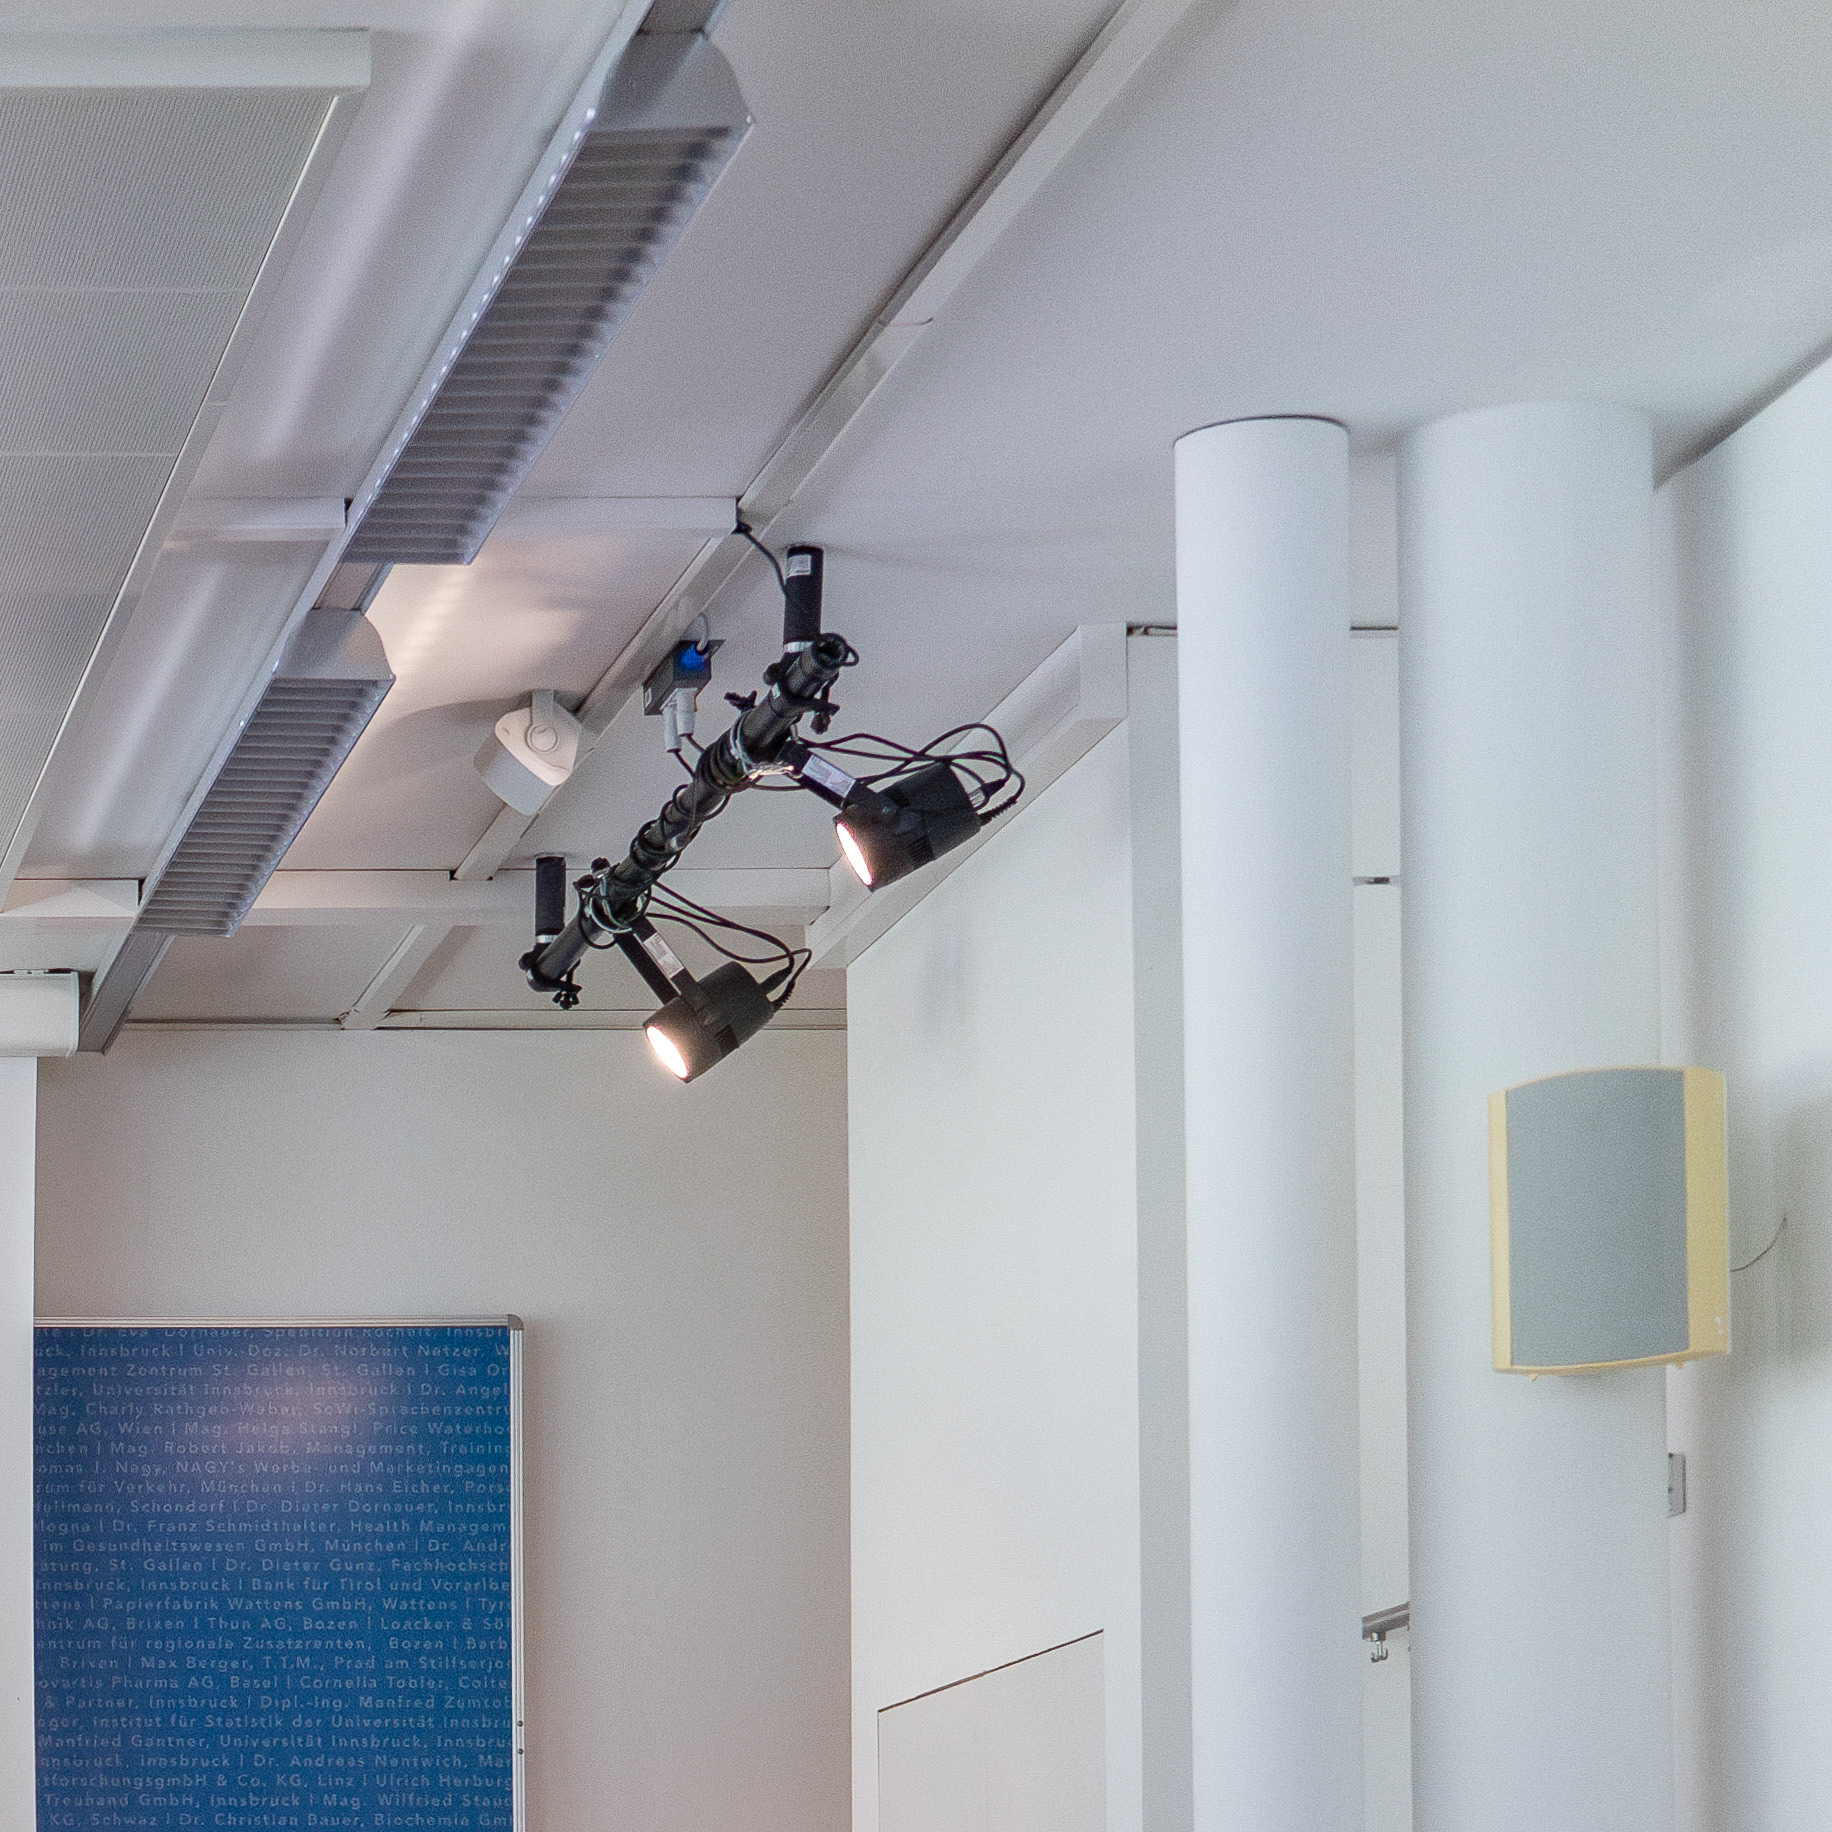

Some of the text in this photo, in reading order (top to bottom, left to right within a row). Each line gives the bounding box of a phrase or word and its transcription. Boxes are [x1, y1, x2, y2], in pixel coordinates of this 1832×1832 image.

[164, 1442, 227, 1454] Robert
[328, 1461, 361, 1474] und
[200, 1480, 283, 1493] München
[339, 1480, 383, 1493] Hans
[72, 1540, 245, 1552] Gesundheitswesen
[324, 1540, 406, 1552] München
[140, 1577, 423, 1591] Innsbruck Bank für Tirol und
[103, 1598, 219, 1613] Papierfabrik
[228, 1598, 303, 1610] Wattens
[382, 1598, 457, 1610] Wattens
[126, 1618, 185, 1630] Brixen
[208, 1618, 251, 1630] Thun
[302, 1618, 358, 1630] Bozen
[380, 1618, 451, 1630] Loacker
[110, 1635, 136, 1649] für
[145, 1636, 234, 1652] regionale
[388, 1636, 444, 1649] Bozen
[140, 1656, 177, 1669] Max
[334, 1656, 376, 1669] Prad
[384, 1659, 410, 1669] am
[91, 1814, 157, 1826] Schwaz
[214, 1814, 299, 1826] Christian
[374, 1814, 470, 1826] Biochemie
